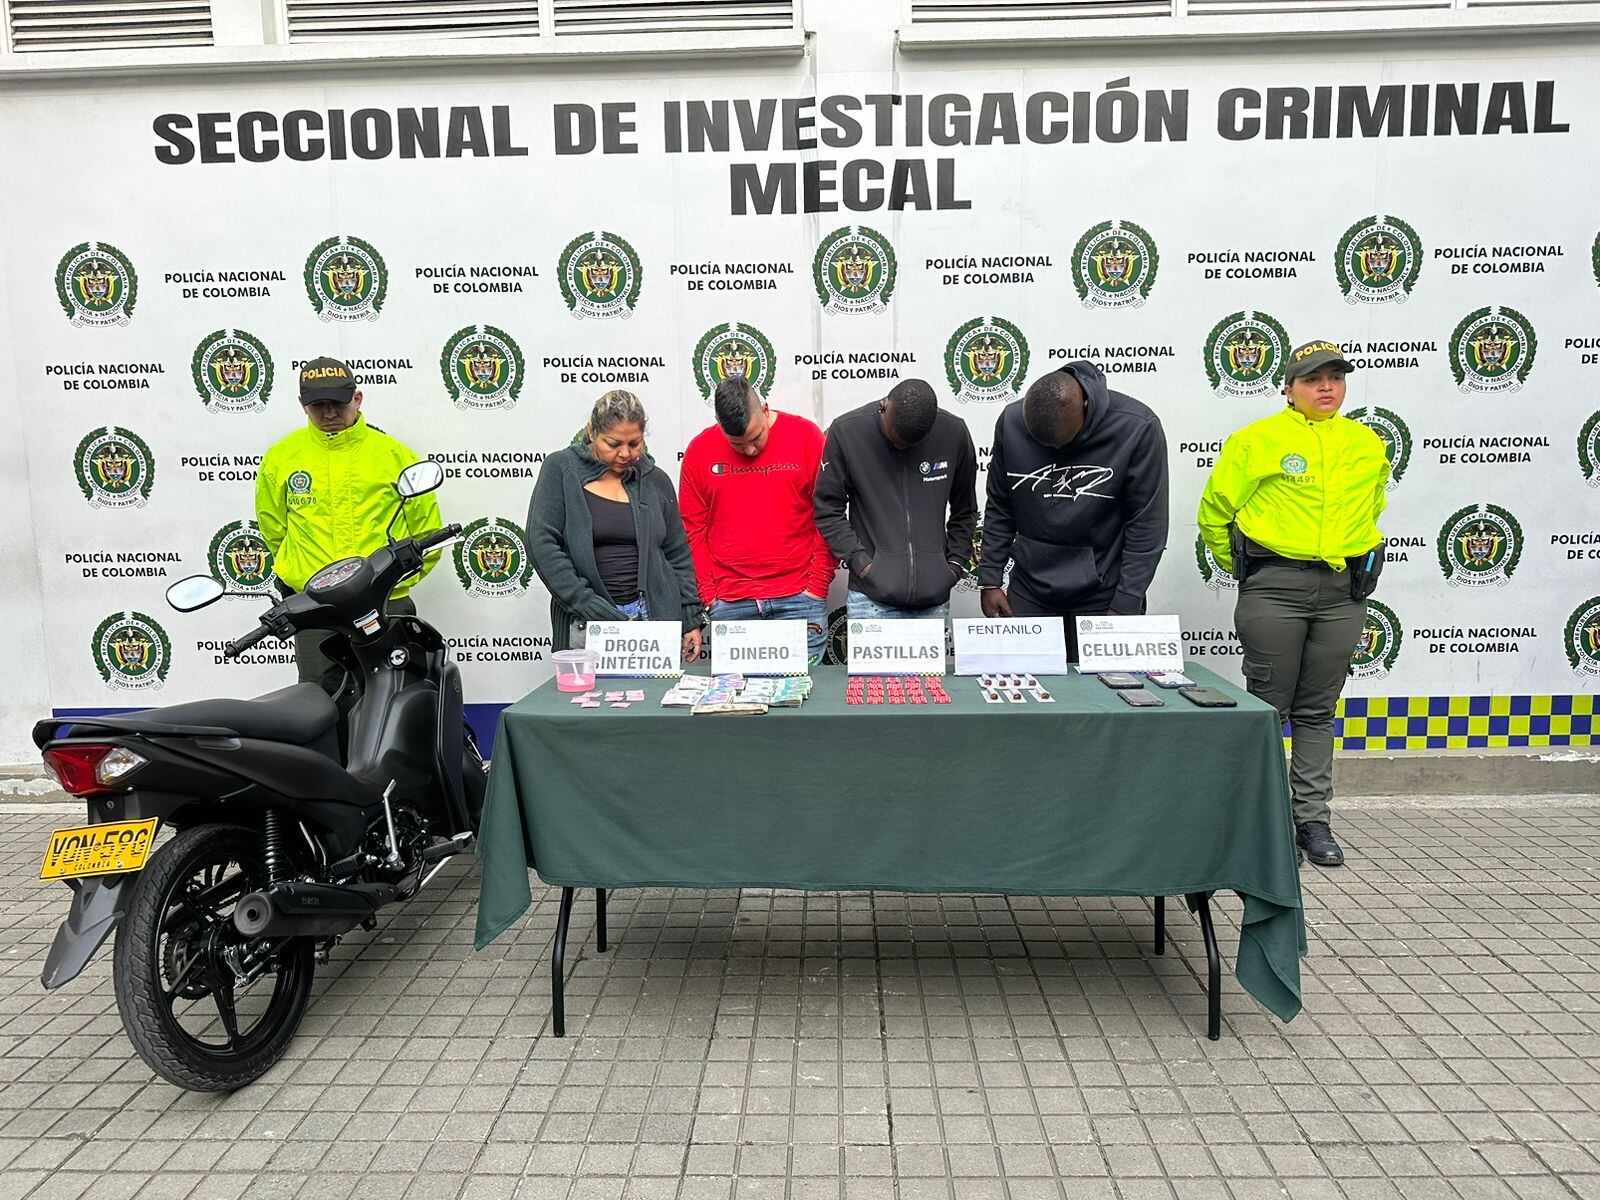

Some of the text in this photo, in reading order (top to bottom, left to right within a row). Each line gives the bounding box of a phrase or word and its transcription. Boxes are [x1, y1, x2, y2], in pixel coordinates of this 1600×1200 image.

[153, 77, 1569, 164] SECCIONAL DE INVESTIGACIÓN CRIMINAL
[731, 158, 971, 215] MECAL
[1081, 234, 1106, 270] REPUBLICA
[1128, 234, 1149, 269] COLOMBIA
[1188, 250, 1316, 264] POLICÍA NACIONAL
[1434, 246, 1564, 258] POLICÍA NACIONAL
[568, 245, 589, 281] REPUBLICA
[611, 245, 632, 280] COLOMBIA
[670, 262, 794, 275] POLICÍA NACIONAL
[926, 256, 1052, 270] POLICÍA NACIONAL
[1451, 262, 1544, 274] DE COLOMBIA
[164, 270, 286, 284] POLICÍA NACIONAL
[416, 265, 539, 278] POLICÍA NACIONAL
[1204, 268, 1297, 279] DE COLOMBIA
[688, 279, 777, 290] DE COLOMBIA
[943, 272, 1034, 285] DE COLOMBIA
[182, 286, 270, 298] DE COLOMBIA
[433, 282, 522, 294] DE COLOMBIA
[1115, 277, 1144, 298] NACIONAL
[602, 288, 630, 309] NACIONAL
[1092, 296, 1108, 306] DIOS
[1114, 296, 1136, 306] PATRIA
[581, 307, 596, 317] DIOS
[602, 307, 624, 317] PATRIA
[1459, 320, 1484, 355] REPUBLICA
[1507, 320, 1527, 354] COLOMBIA
[1565, 338, 1600, 348] POLI
[954, 330, 978, 366] REPUBLICA
[1000, 330, 1020, 364] COLOMBIA
[1048, 346, 1175, 359] POLICÍA NACIONAL
[1367, 342, 1438, 353] NACIONAL
[202, 342, 221, 376] REPUBLICA
[243, 342, 264, 375] COLOMBIA
[543, 356, 666, 368] POLICÍA NACIONAL
[794, 352, 916, 365] POLICÍA NACIONAL
[1582, 354, 1598, 364] DE
[46, 362, 165, 376] POLICÍA NACIONAL
[812, 368, 899, 380] DE COLOMBIA
[1096, 362, 1157, 373] OLOMBIA
[1492, 362, 1522, 383] NACIONAL
[302, 367, 347, 382] POLICIA
[354, 374, 397, 384] OMBIA
[561, 372, 649, 383] DE COLOMBIA
[64, 378, 150, 390] DE COLOMBIA
[987, 372, 1016, 392] NACIONAL
[1469, 381, 1484, 391] DIOS
[1490, 381, 1513, 391] PATRIA
[236, 383, 262, 403] NACIONAL
[966, 391, 981, 401] DIOS
[987, 391, 1008, 401] PATRIA
[216, 401, 230, 411] DIOS
[237, 401, 257, 411] PATRIA
[1180, 439, 1223, 453] POLICÍ
[1423, 436, 1550, 449] POLICÍA NACIONAL
[181, 454, 230, 467] POLICÍA
[1196, 458, 1213, 468] DE
[1440, 452, 1531, 464] DE COLOMBIA
[198, 470, 258, 482] DE COLO
[446, 468, 534, 478] DE COLOMBIA
[710, 462, 801, 477] Champion
[1447, 517, 1472, 550] REPUBLICA
[1494, 517, 1514, 549] COLOMBIA
[1383, 537, 1426, 548] IONAL
[66, 551, 182, 564] POLICÍA NACIONAL
[1567, 550, 1584, 560] DE
[82, 567, 167, 578] DE COLOMBIA
[1479, 558, 1509, 577] NACIONAL
[1457, 575, 1472, 585] DIOS
[1478, 575, 1500, 585] PATRIA
[968, 624, 1043, 635] FENTANILO
[1180, 628, 1224, 641] OLICÍA
[1413, 626, 1537, 639] POLICÍA NACIONAL
[445, 636, 552, 648] OLICÍA NACIONA
[605, 639, 660, 652] DROGA
[1430, 642, 1519, 654] DE COLOMBIA
[730, 646, 790, 660] DINERO
[853, 646, 940, 660] PASTILLAS
[1083, 642, 1178, 657] CELULARES
[1190, 646, 1244, 656] DE COLO
[214, 655, 230, 664] DE
[456, 651, 542, 662] DE COLOMBIA
[596, 654, 673, 670] INTÉTICA
[74, 861, 111, 871] COLOMBIA
